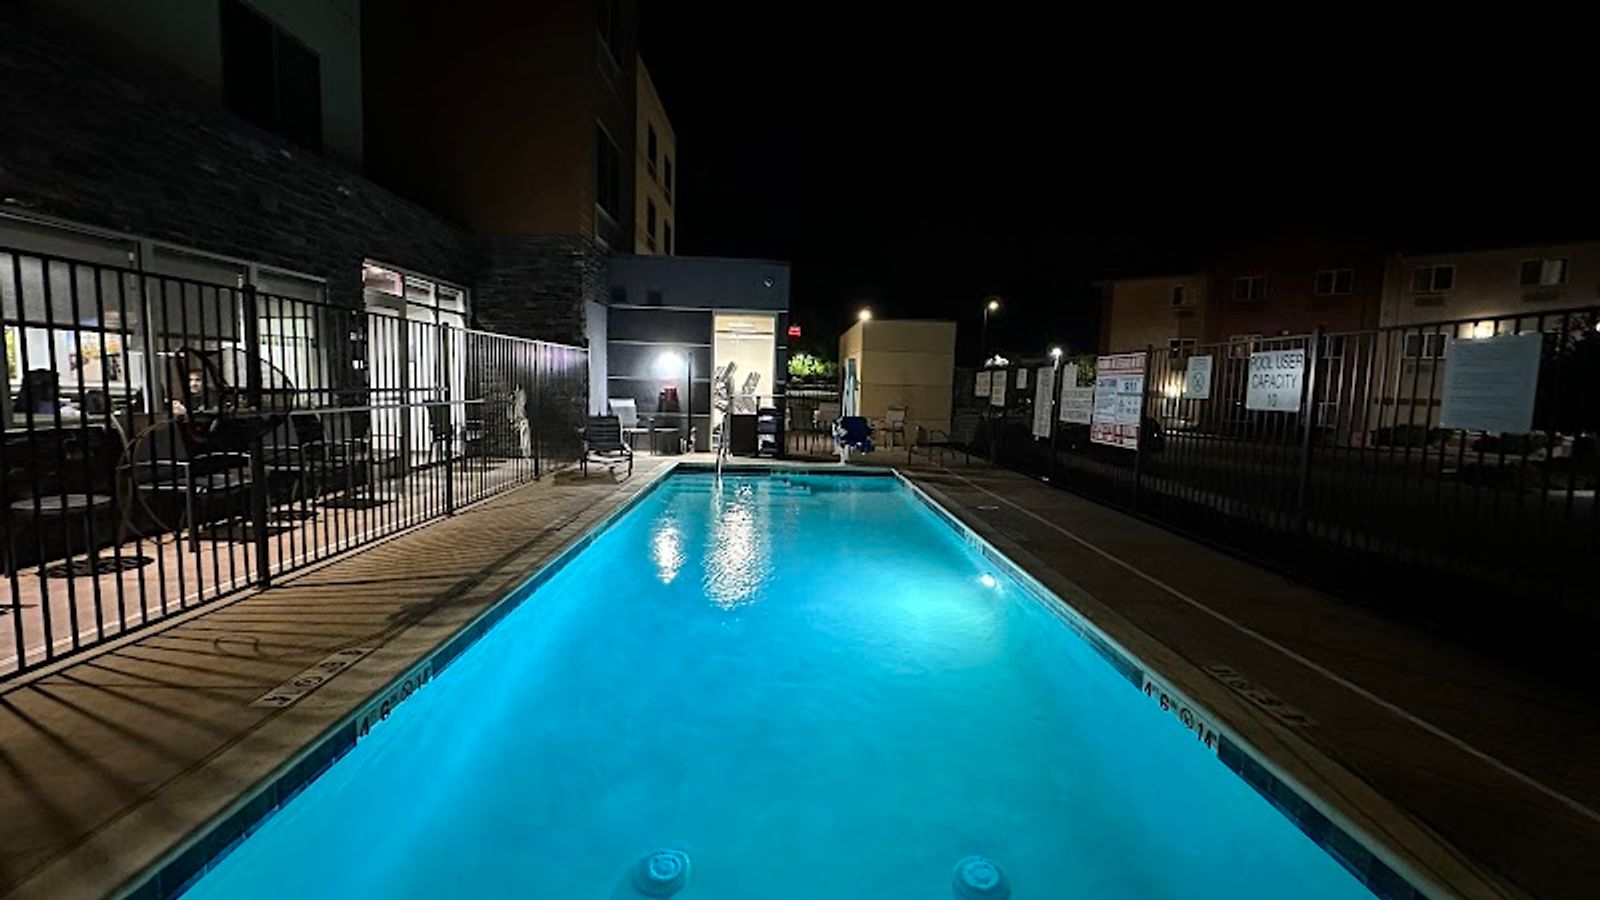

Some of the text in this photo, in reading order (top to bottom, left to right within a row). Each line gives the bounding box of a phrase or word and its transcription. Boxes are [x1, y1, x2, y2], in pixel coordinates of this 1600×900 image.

[1250, 353, 1303, 371] POOL USER
[1252, 373, 1297, 389] CAPACITY
